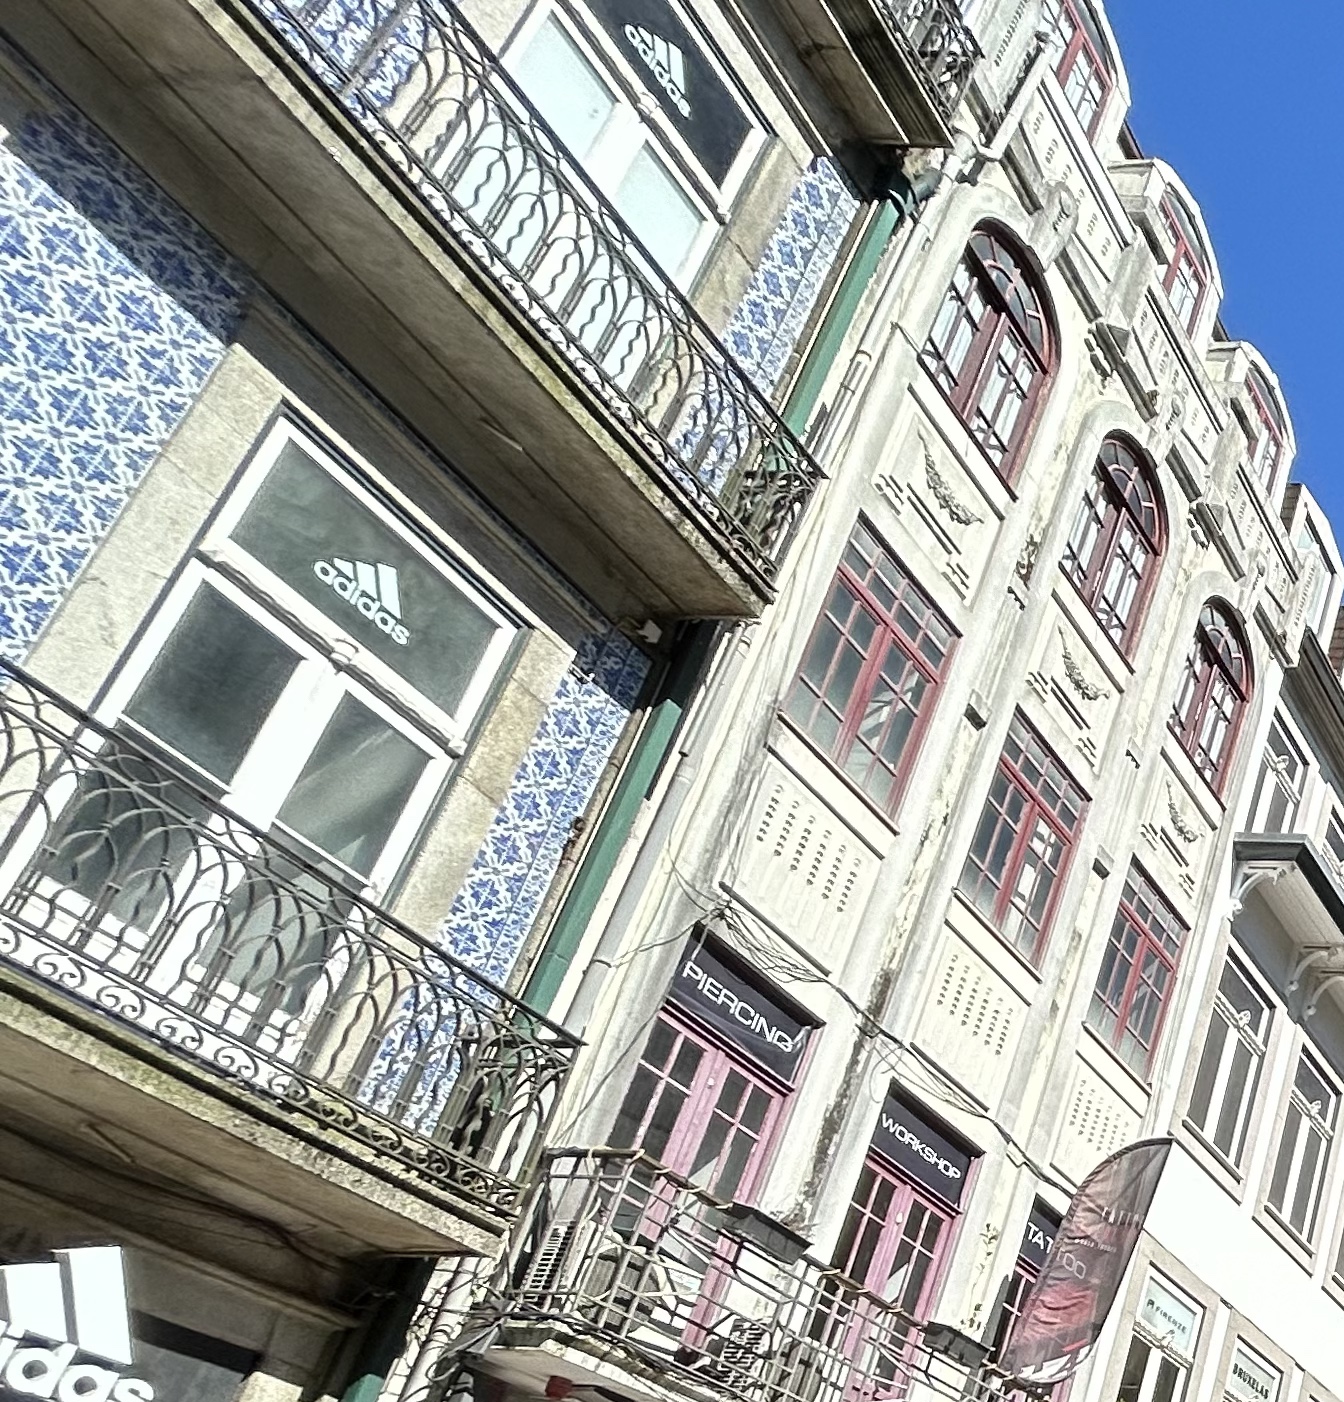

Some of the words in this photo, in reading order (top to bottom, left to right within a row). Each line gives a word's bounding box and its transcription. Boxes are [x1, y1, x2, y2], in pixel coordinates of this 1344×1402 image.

[624, 23, 691, 119] adidas
[313, 559, 411, 645] adidas
[682, 960, 797, 1053] PIERCING
[881, 1112, 961, 1180] WORKSHOP
[1232, 1362, 1270, 1400] BRUXELAS
